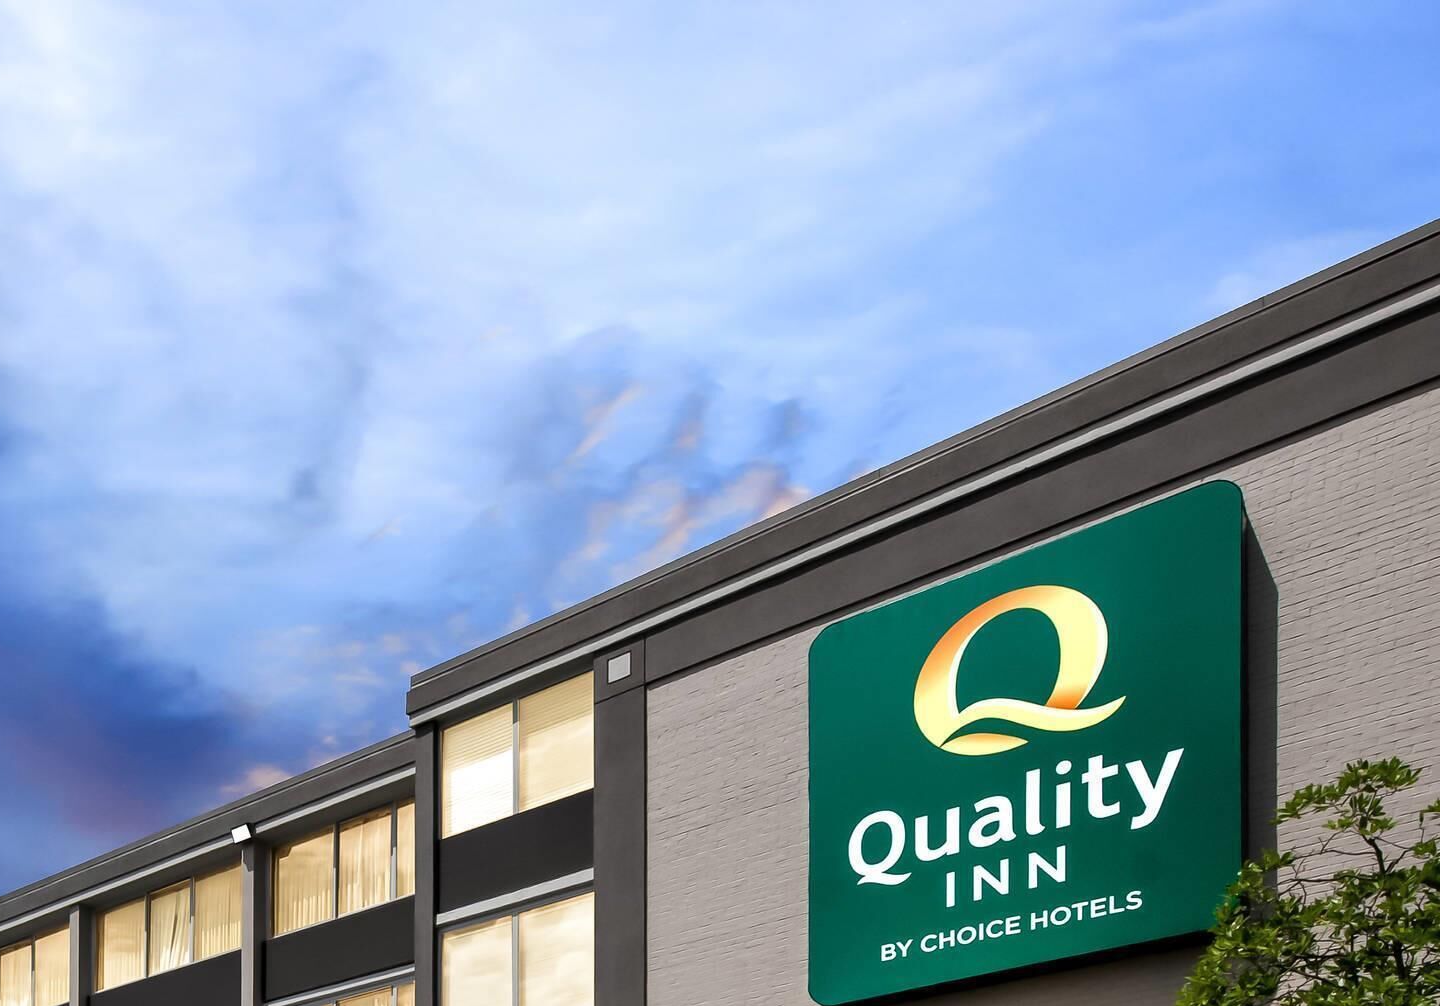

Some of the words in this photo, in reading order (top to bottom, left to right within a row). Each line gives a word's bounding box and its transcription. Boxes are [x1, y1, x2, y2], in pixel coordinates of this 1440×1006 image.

[848, 747, 1185, 886] Quality
[946, 845, 1067, 908] INN
[880, 939, 913, 962] BY
[920, 915, 1022, 953] CHOICE
[1030, 890, 1144, 931] HOTELS
